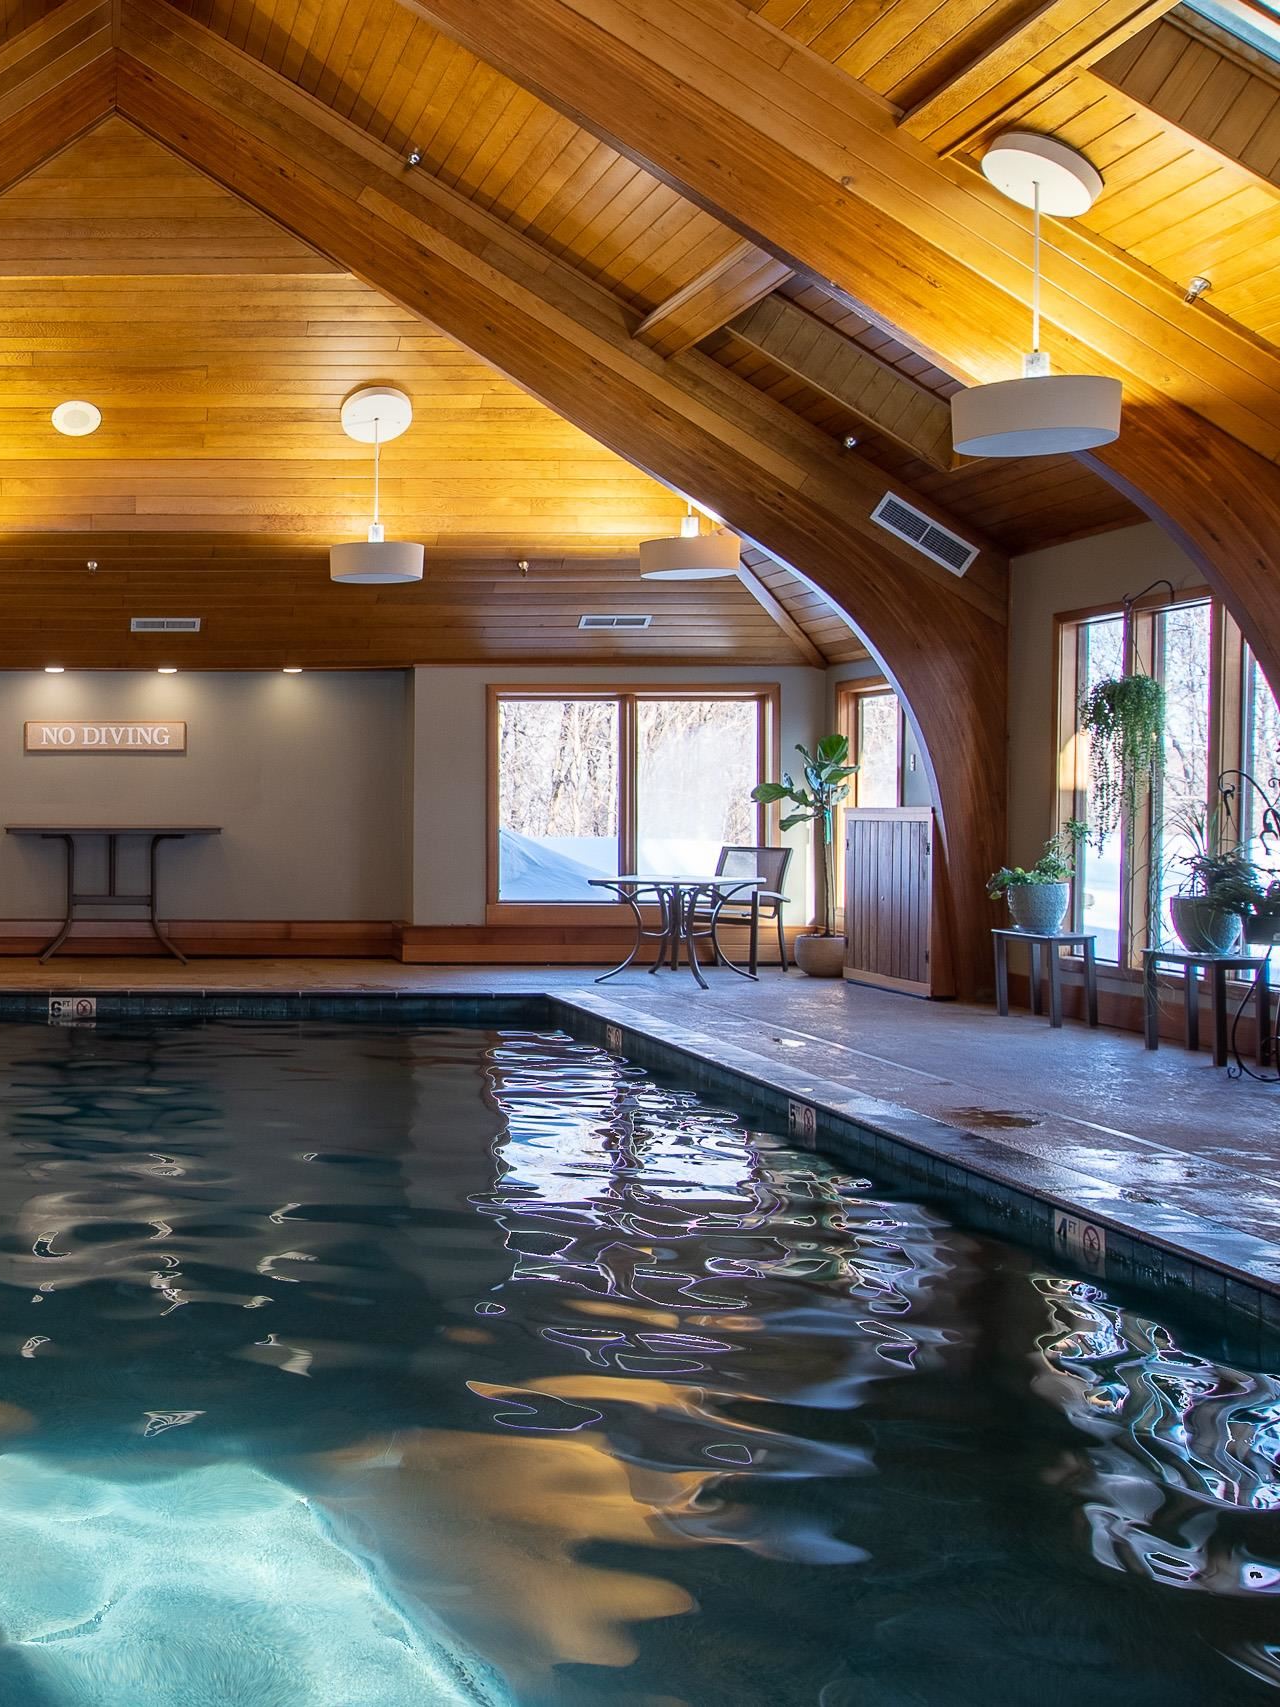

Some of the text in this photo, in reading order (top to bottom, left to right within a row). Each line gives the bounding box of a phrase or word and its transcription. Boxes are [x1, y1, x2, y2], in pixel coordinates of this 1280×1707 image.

[41, 727, 170, 745] NO DIVING
[51, 1001, 62, 1014] 6
[1057, 1217, 1077, 1239] 4 FT
